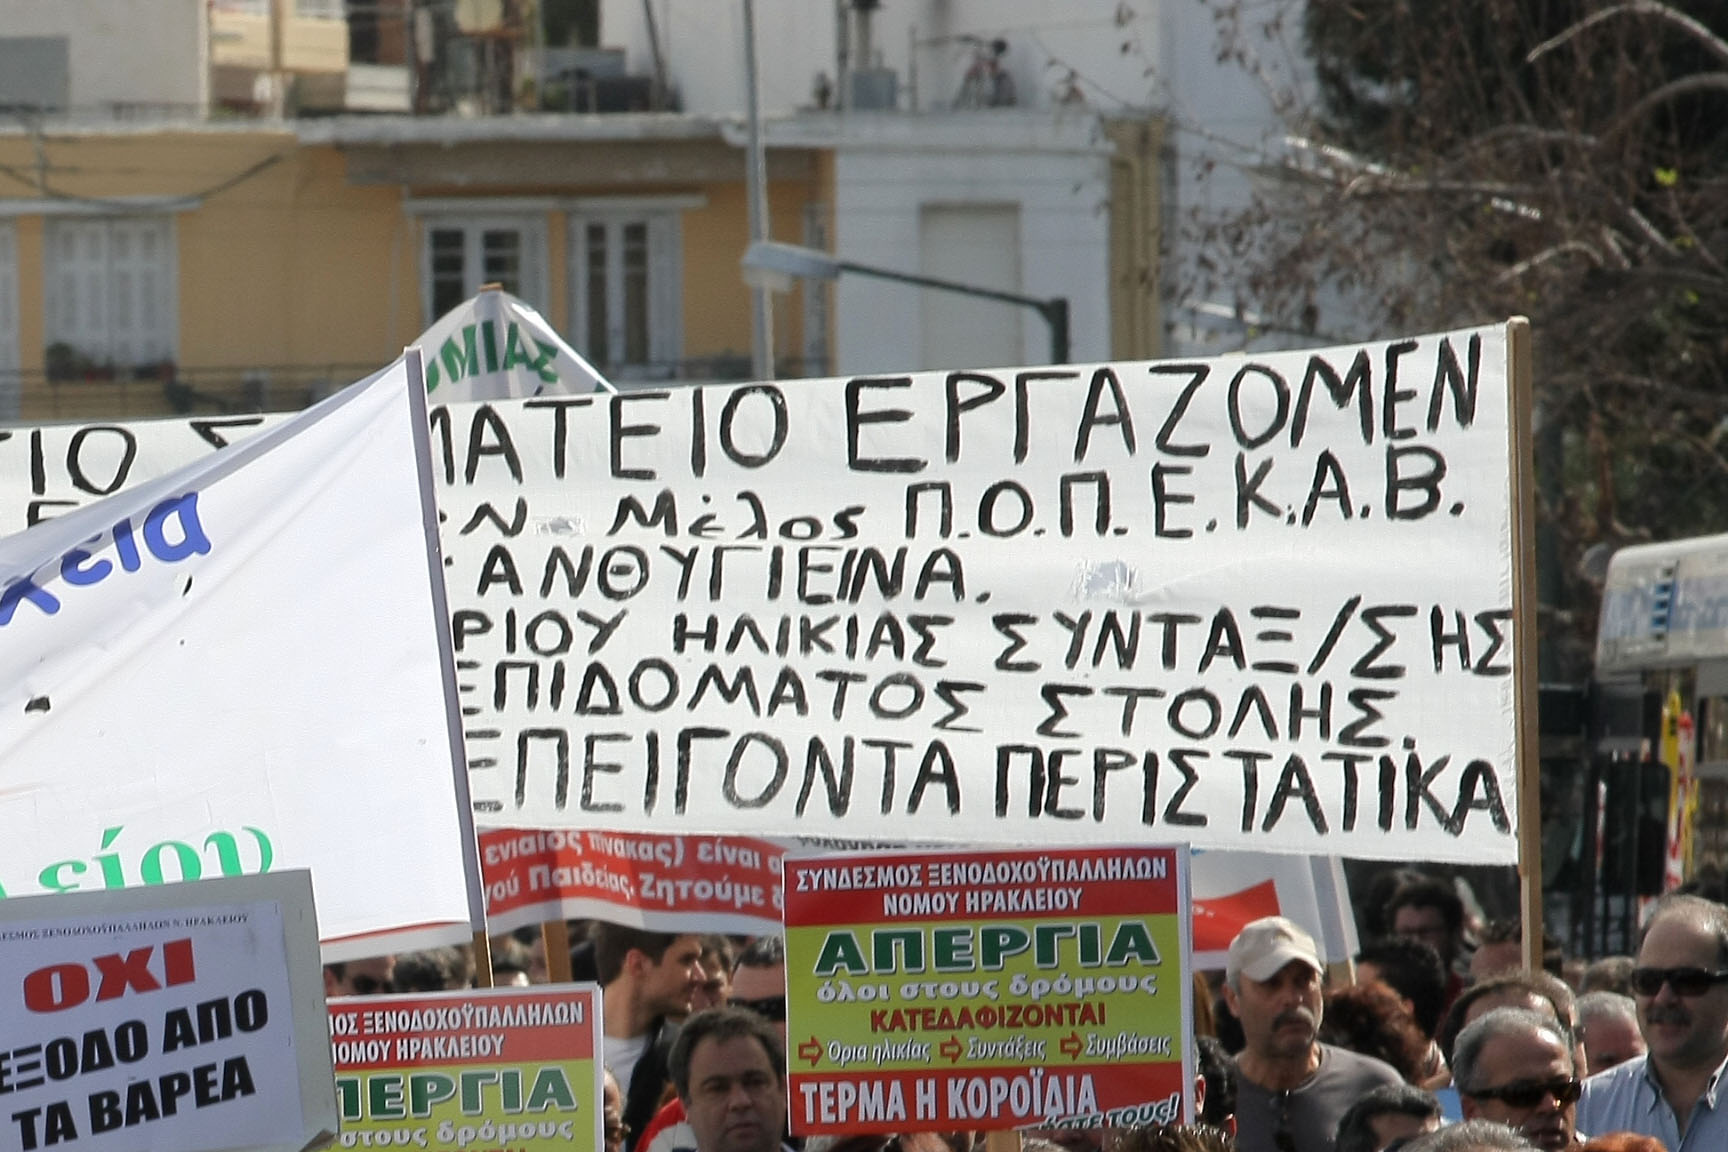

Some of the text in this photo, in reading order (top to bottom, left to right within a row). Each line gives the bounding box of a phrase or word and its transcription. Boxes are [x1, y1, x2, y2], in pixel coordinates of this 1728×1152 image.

[846, 333, 1481, 473] ΕΡΓΑΖΟΜΕΝ
[607, 487, 865, 541] Μέλος
[905, 444, 1465, 540] Π.Ο.Π.Ε.Κ.Α.Β.
[673, 610, 955, 666] ΗΛΙΚΙΑΣ
[456, 658, 987, 732] ΕΠΙΔΟΜΑΤΟΣ
[465, 728, 1512, 836] ΕΠΕΙΓΟΝΤΑ ΠΕΡΙΣΤΑΤΙΚΑ
[639, 872, 765, 908] Ζητούμε
[796, 863, 923, 893] ΣΥΝΔΕΣΜΟΣ
[883, 887, 1083, 917] ΝΟΜΟΥ ΗΡΑΚΛΕΙΟΥ
[23, 938, 196, 1013] ΟΧΙ
[813, 920, 1163, 977] ΑΠΕΡΓΙΑ
[816, 972, 1158, 1003] όλοι στους δρόμους
[162, 989, 268, 1054] ΑΠΟ
[870, 1001, 1107, 1033] ΚΑΤΕΔΑΦΙΖΟΝΤΑΙ
[396, 1034, 505, 1062] ΗΡΑΚΛΕΙΟΥ
[826, 1031, 1172, 1066] Όρια ηλικίας Συντάξεις Συμβάσεις
[11, 1055, 256, 1152] ΤΑ ΒΑΡΕΑ
[799, 1066, 1099, 1125] ΤΕΡΜΑ Η ΚΟΡΟΪΔΙΑ
[340, 1119, 574, 1148] στους δρόμους
